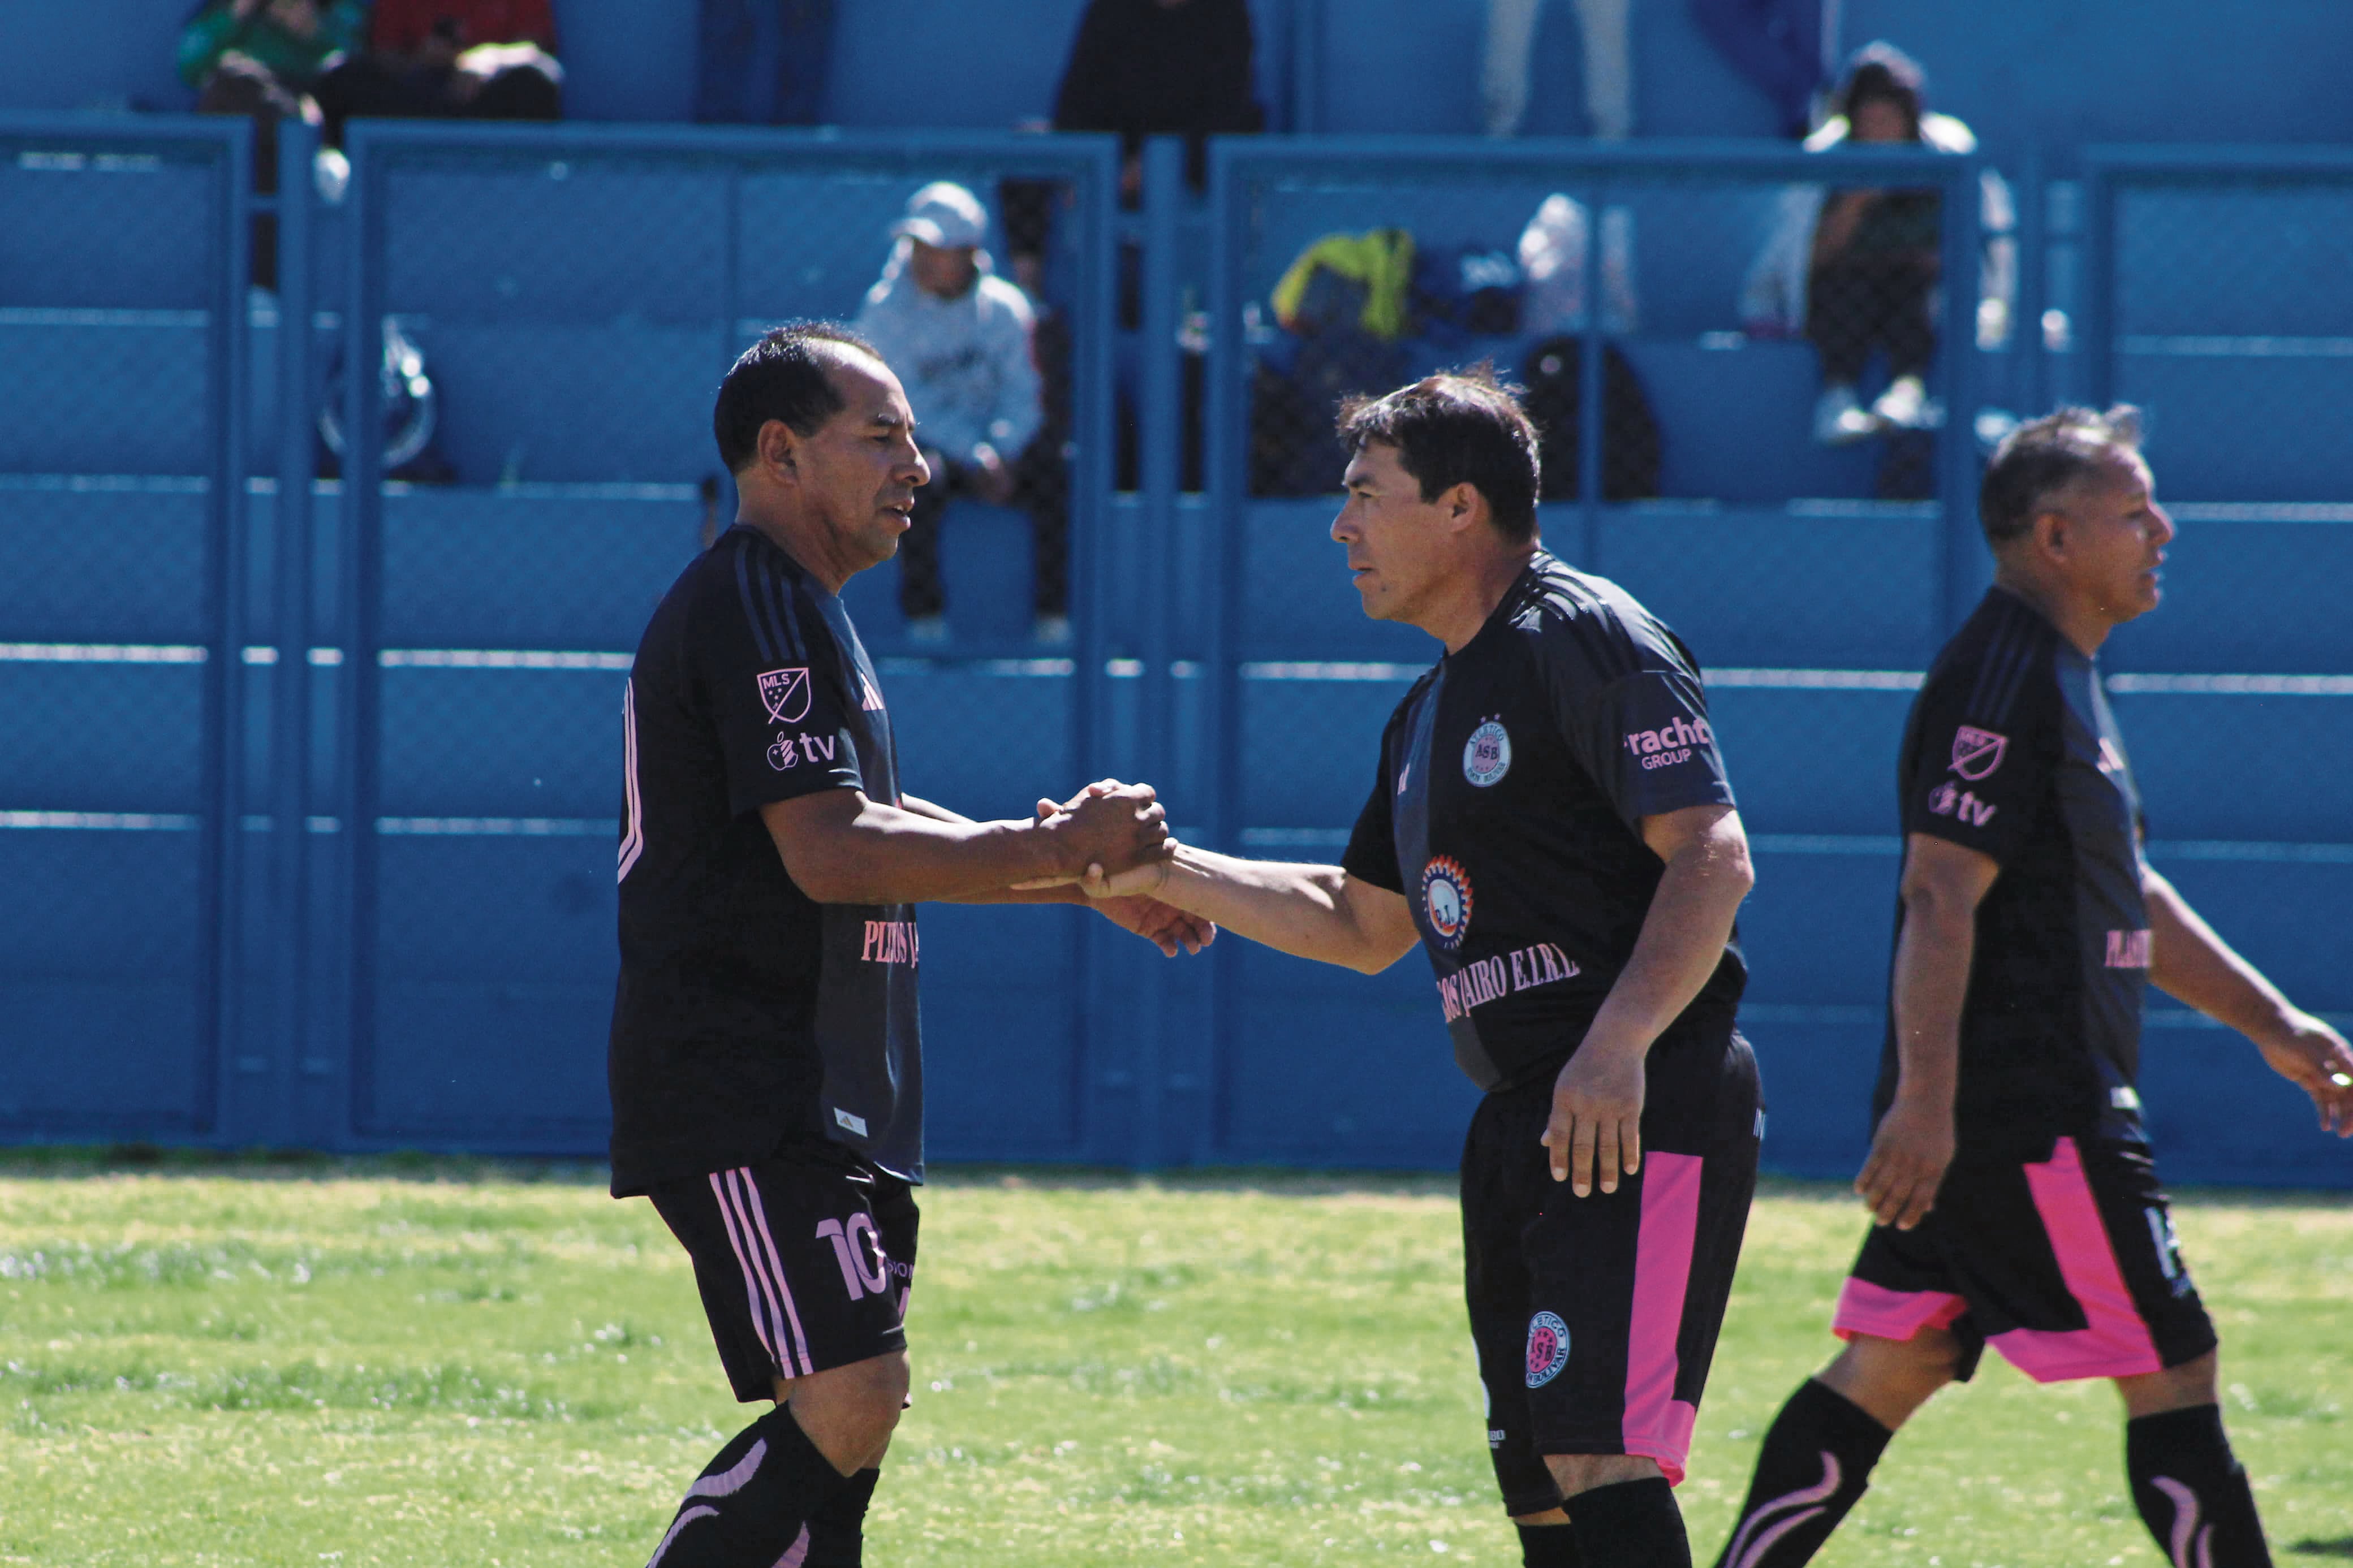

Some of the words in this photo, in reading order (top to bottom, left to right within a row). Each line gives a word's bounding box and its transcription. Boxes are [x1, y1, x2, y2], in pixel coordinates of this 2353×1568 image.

[762, 673, 790, 689] MLS
[799, 732, 835, 763] tv
[1623, 716, 1710, 755] racht
[1475, 744, 1498, 760] ASB
[1641, 748, 1692, 770] GROUP
[1958, 792, 1997, 827] tv
[816, 1212, 887, 1301] 10
